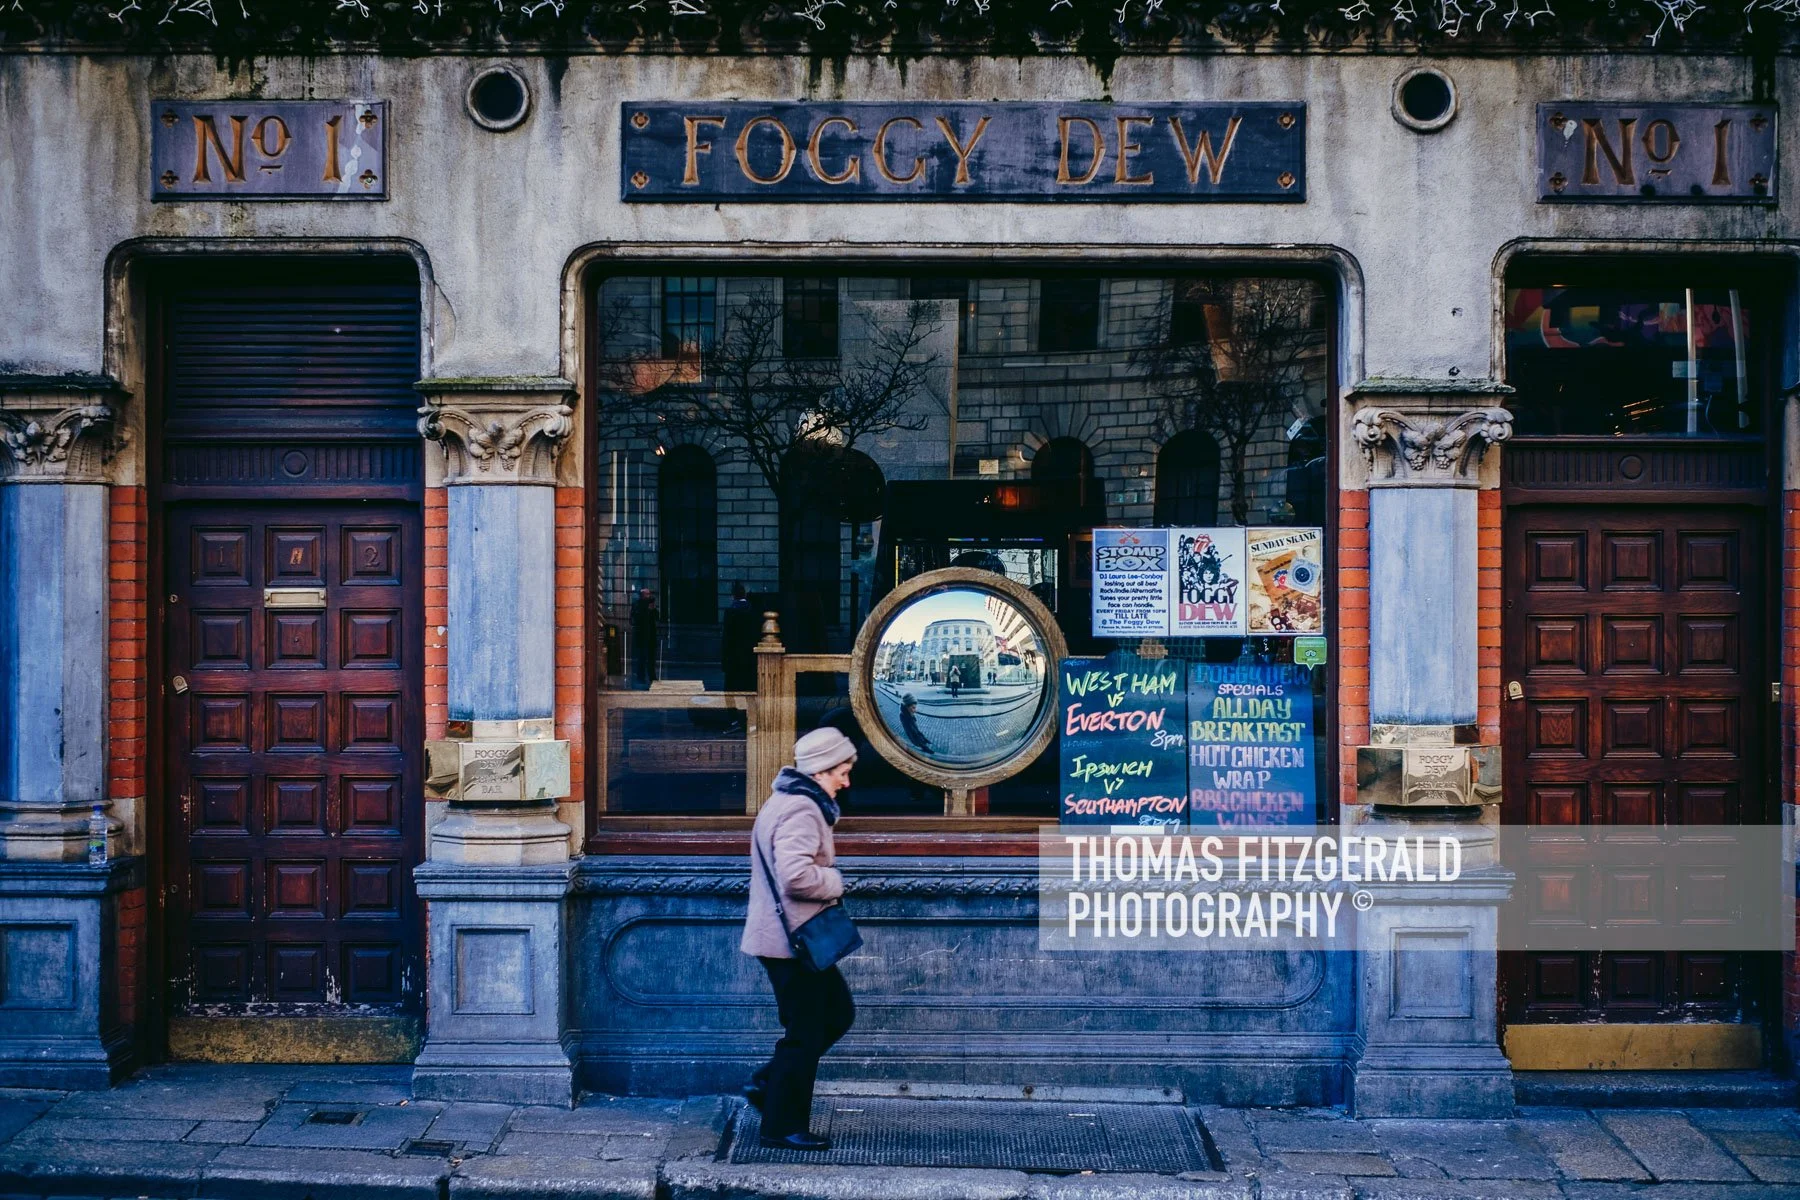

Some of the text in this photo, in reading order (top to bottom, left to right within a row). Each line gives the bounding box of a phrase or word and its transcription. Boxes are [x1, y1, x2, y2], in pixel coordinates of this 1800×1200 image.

[322, 115, 343, 184] 1
[682, 116, 1243, 185] FOGGY DEW
[1711, 118, 1733, 186] 1
[1250, 531, 1317, 552] SUNDAY SKANK
[364, 545, 380, 567] 2
[1096, 546, 1166, 558] STOMP
[1097, 556, 1165, 571] BOX
[1179, 587, 1237, 604] FOGGY
[1178, 603, 1238, 621] DEW
[1066, 671, 1177, 697] WEST HAM
[1218, 683, 1284, 696] SPECIALS
[1066, 702, 1167, 736] EVERTON
[1190, 721, 1306, 742] BREAKFAST
[474, 750, 510, 758] FOGGY
[1419, 755, 1455, 764] FOGGY
[1424, 765, 1449, 774] DEW
[1213, 770, 1271, 789] WRAP
[1064, 792, 1188, 817] SOUTHAMPTON
[1217, 813, 1289, 832] WINGS
